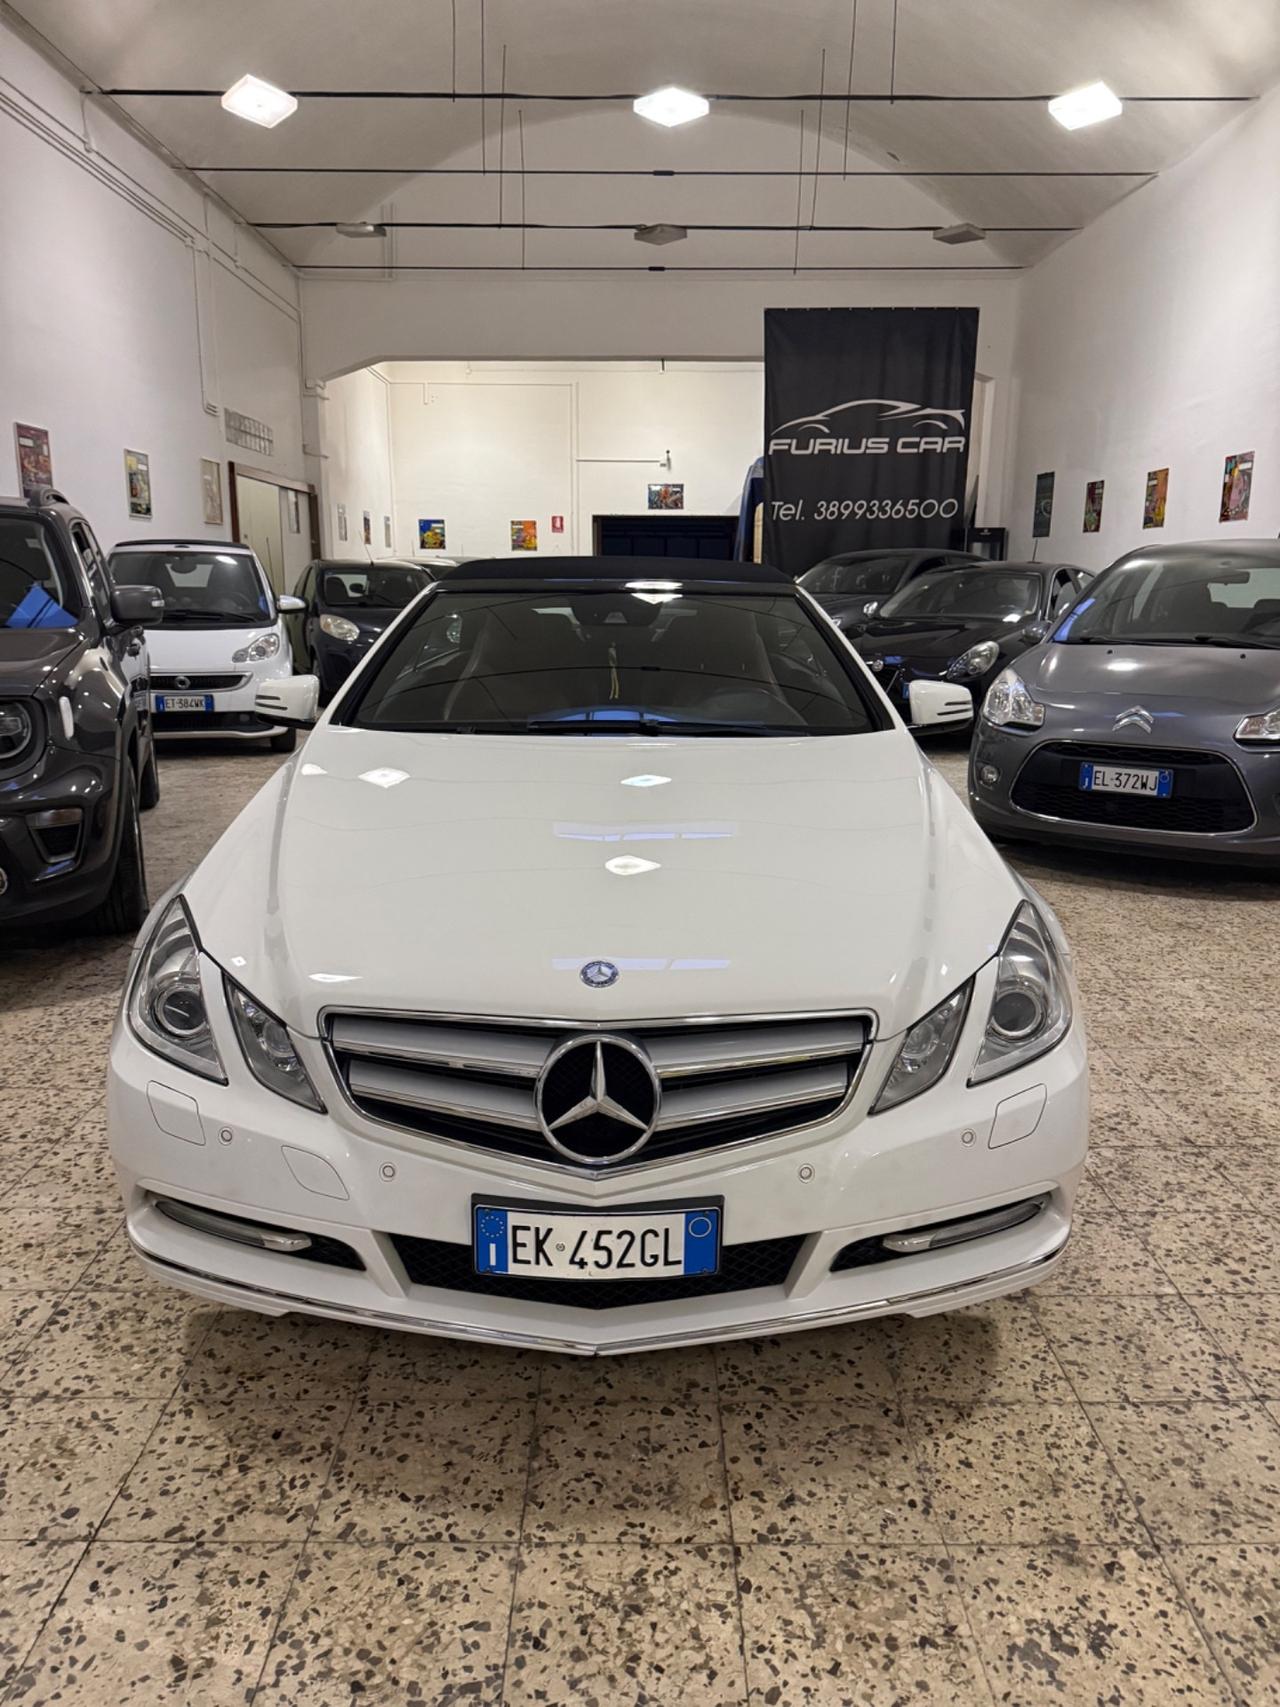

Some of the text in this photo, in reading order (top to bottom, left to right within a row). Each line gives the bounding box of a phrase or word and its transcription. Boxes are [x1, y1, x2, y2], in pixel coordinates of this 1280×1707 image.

[768, 437, 966, 455] FURIUS CAR
[771, 499, 959, 521] Tel. 3899336500
[1093, 770, 1158, 791] EL 372WJ
[511, 1225, 683, 1270] EK 452GL
